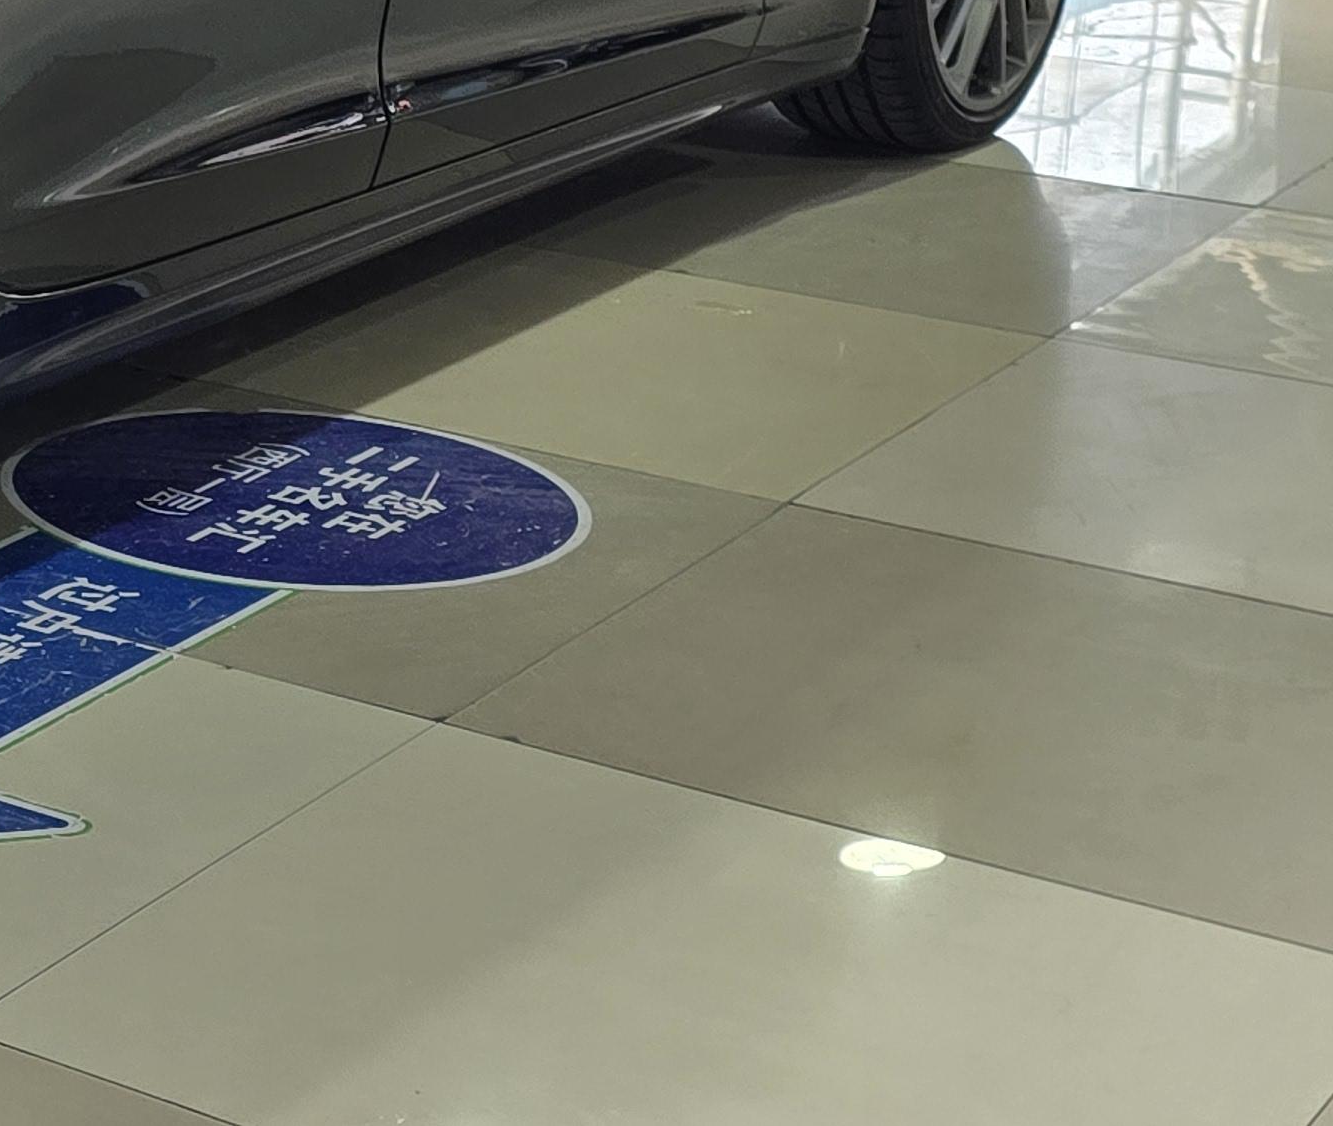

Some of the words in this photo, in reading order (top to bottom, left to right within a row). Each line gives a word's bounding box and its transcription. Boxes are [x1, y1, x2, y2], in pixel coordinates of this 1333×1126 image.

[186, 446, 421, 554] 二手名车汇
[321, 488, 449, 541] 您在
